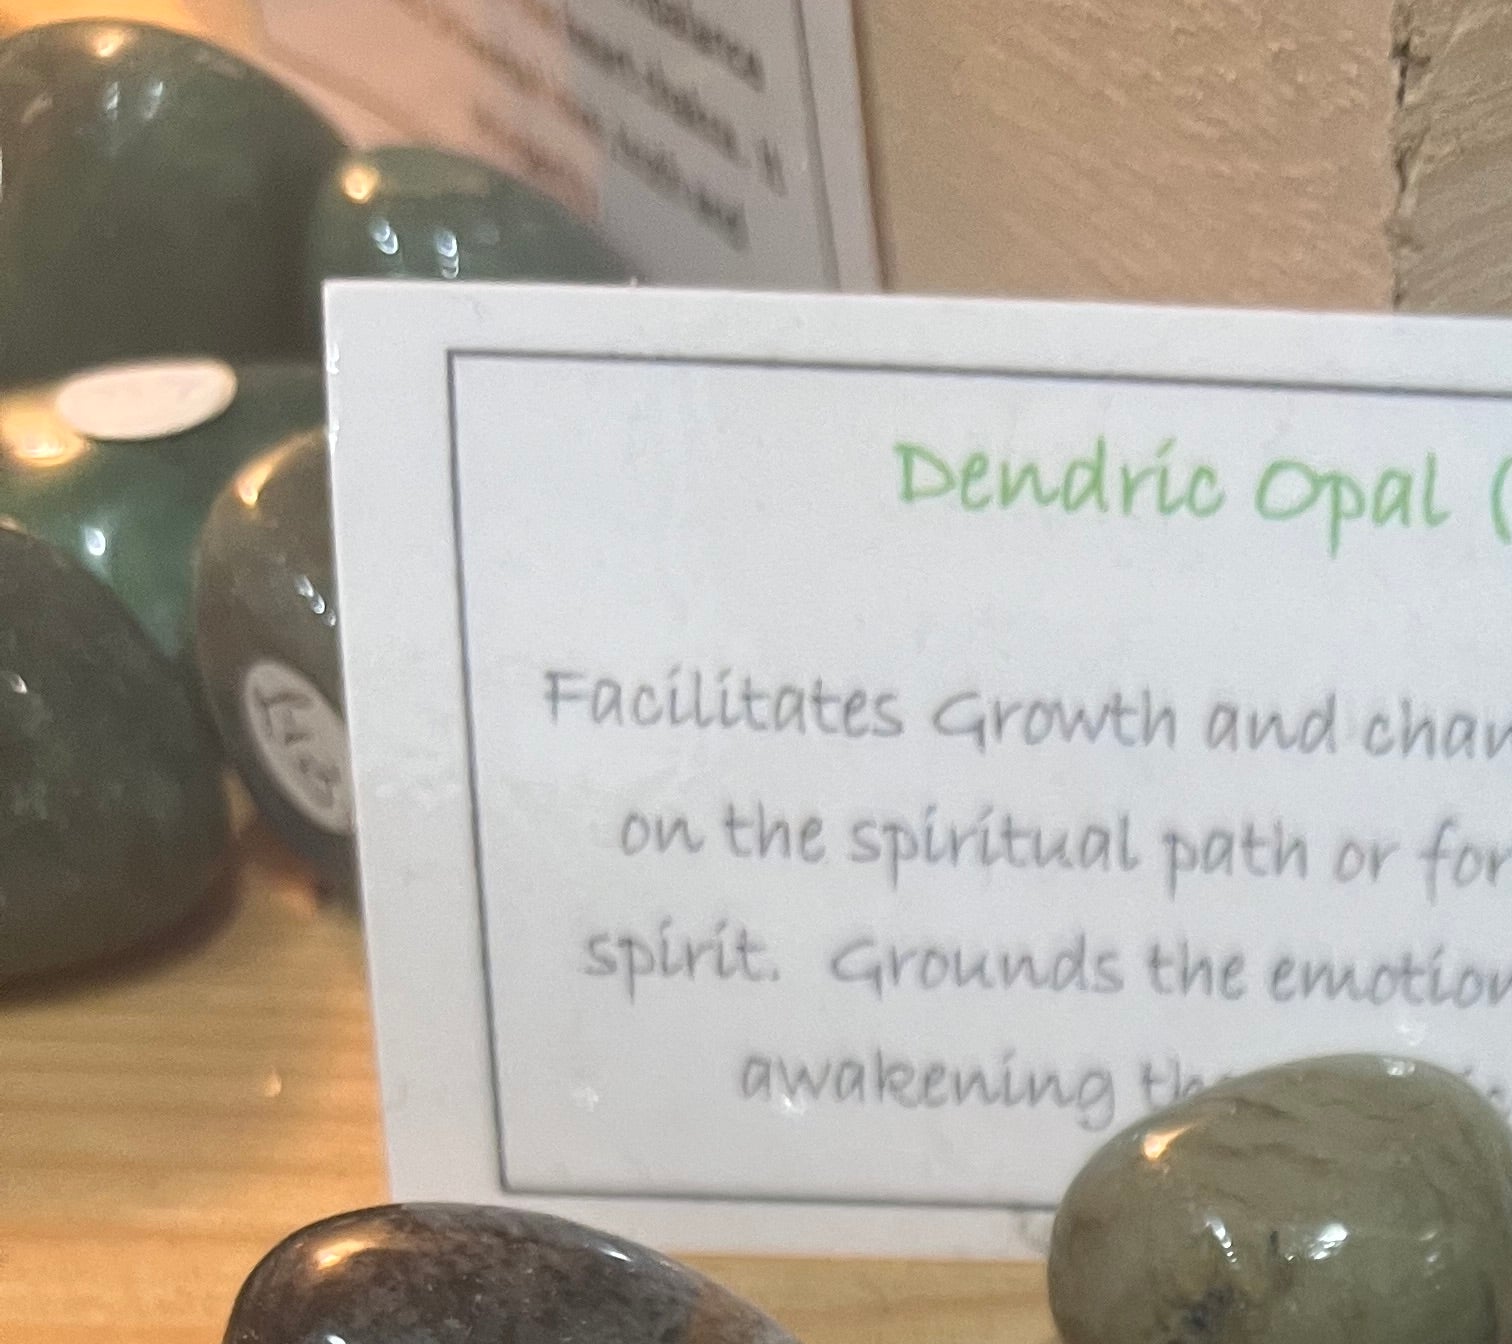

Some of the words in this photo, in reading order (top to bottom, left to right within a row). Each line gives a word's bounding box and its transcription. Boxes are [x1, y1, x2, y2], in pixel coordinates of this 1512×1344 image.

[892, 435, 1226, 519] Dendric
[1254, 453, 1450, 559] Opal
[543, 665, 904, 738] Facilitates
[930, 688, 1176, 753] Growth
[1205, 692, 1336, 754] and
[619, 810, 704, 855] on
[721, 802, 825, 863] the
[850, 804, 1140, 888] spiritual
[1161, 821, 1308, 897] path
[1333, 837, 1398, 882] or
[584, 917, 779, 1000] spirit.
[828, 933, 1123, 996] Grounds
[1145, 940, 1245, 1001] the
[738, 1049, 1114, 1132] awakening
[1138, 1058, 1235, 1102] th
